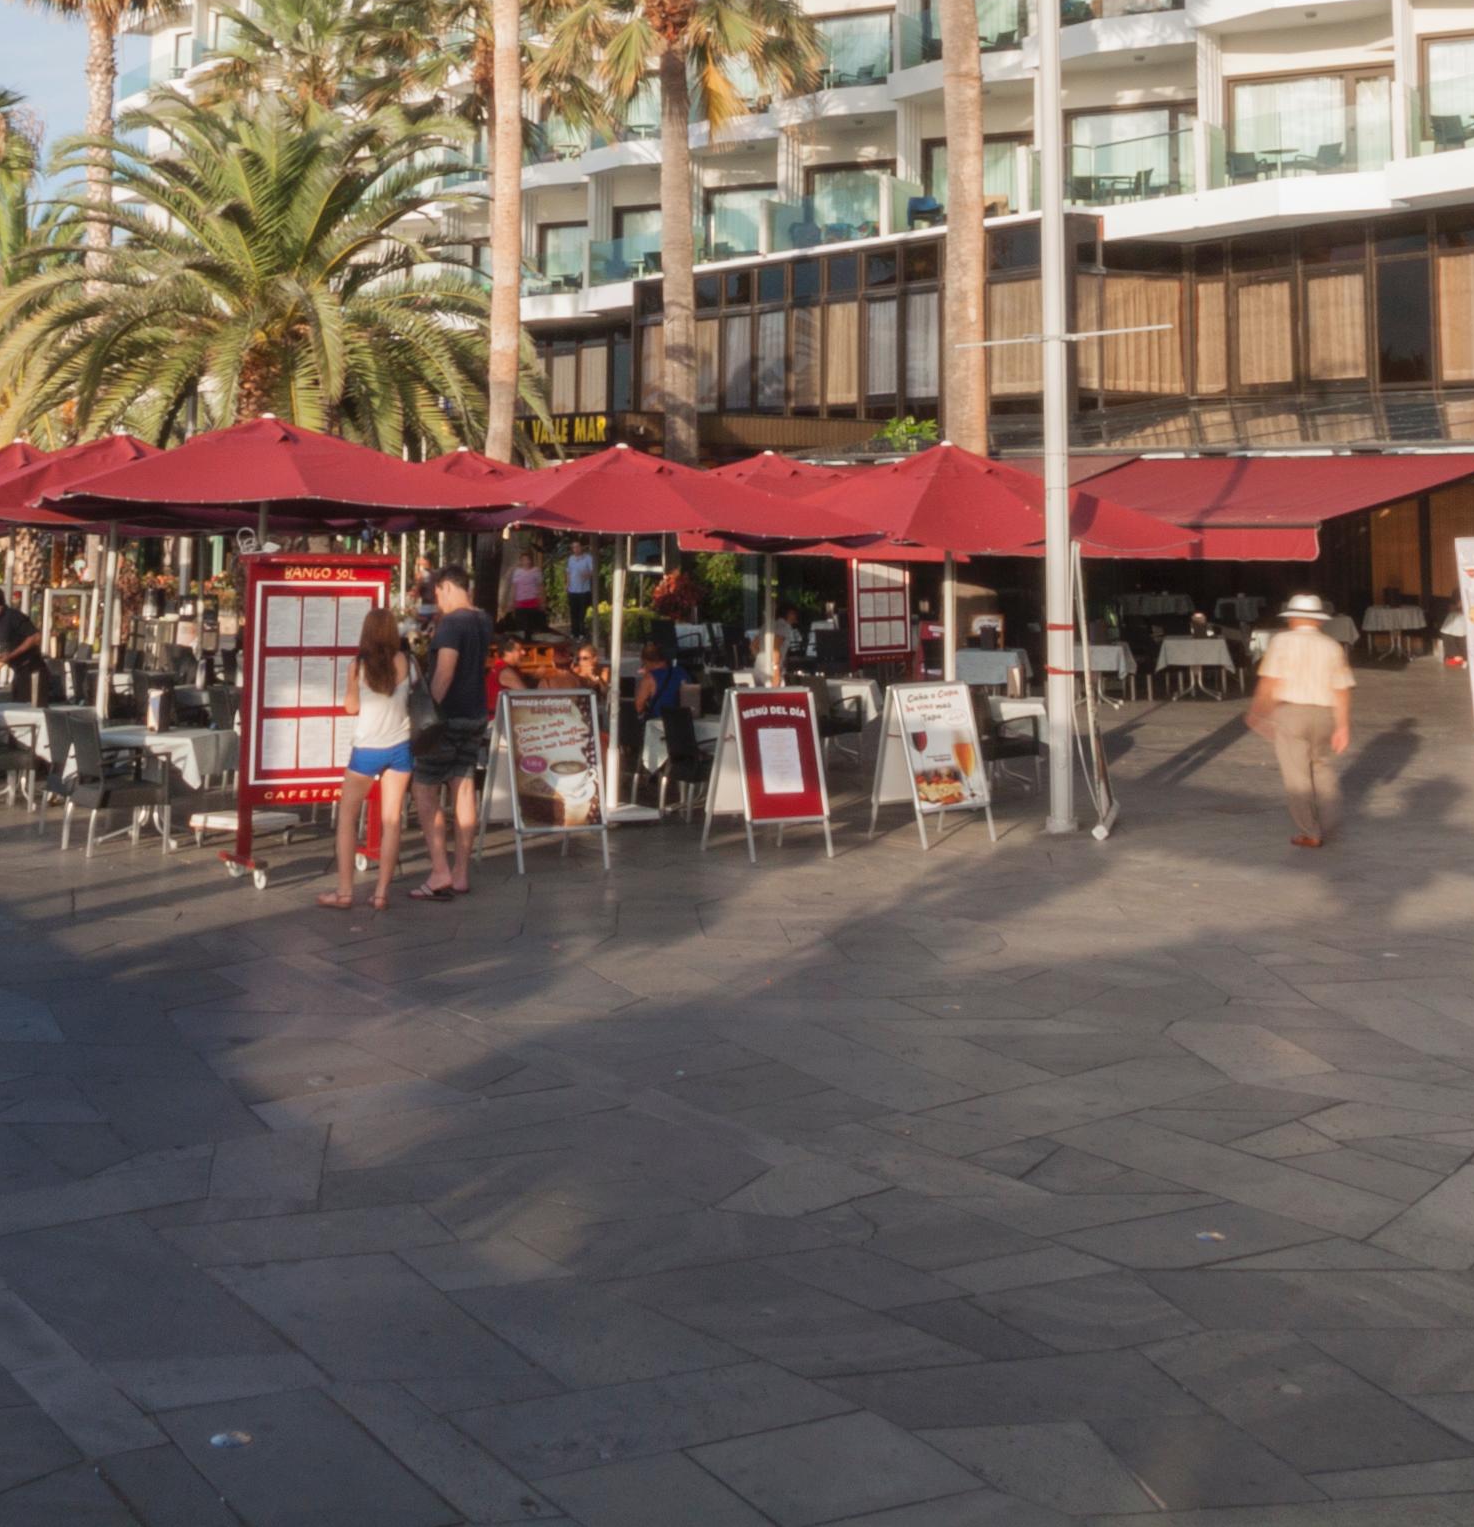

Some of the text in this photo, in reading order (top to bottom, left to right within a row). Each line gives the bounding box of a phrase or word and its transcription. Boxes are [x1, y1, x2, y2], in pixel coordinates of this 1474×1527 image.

[532, 417, 568, 444] VALE
[574, 415, 607, 442] MAR
[284, 566, 357, 581] BANGO SOL
[769, 705, 787, 715] DEL
[789, 706, 806, 718] DÍA
[264, 788, 343, 801] CAFETER
